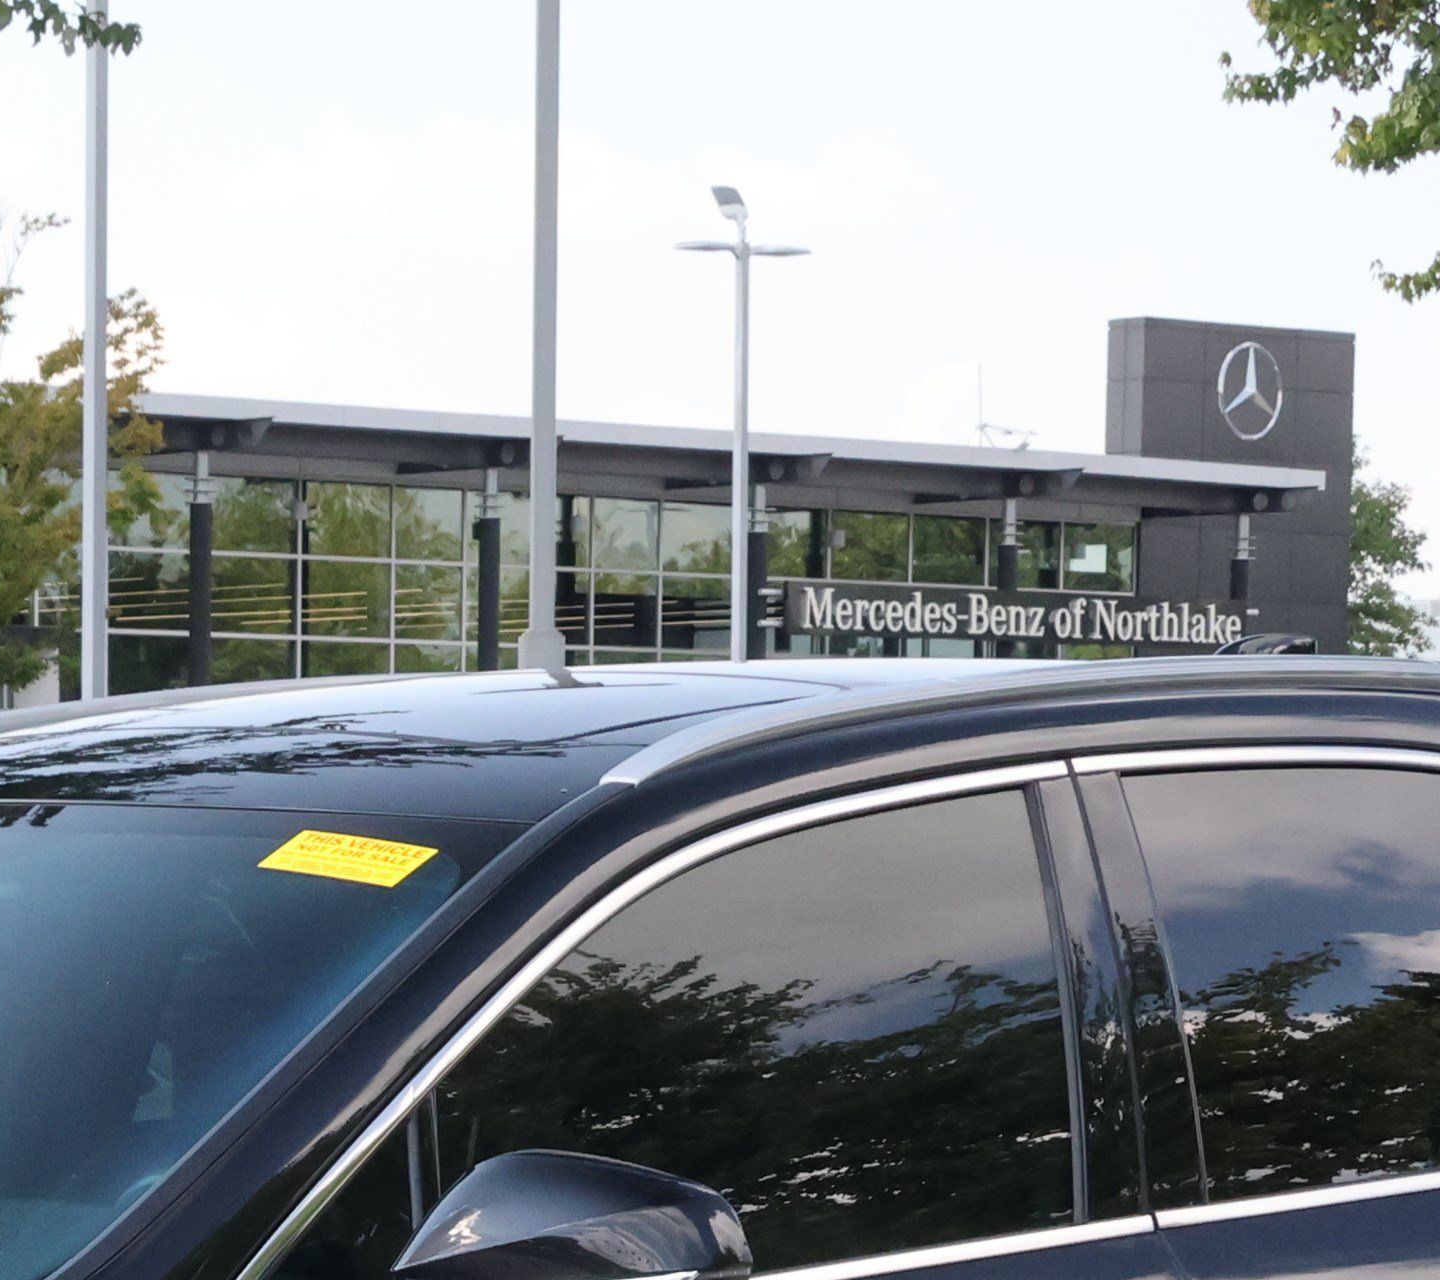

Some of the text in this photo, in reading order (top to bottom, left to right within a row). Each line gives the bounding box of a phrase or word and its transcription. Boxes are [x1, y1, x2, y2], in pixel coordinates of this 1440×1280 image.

[802, 586, 1242, 644] Mercedes-Benz of Northlake
[297, 843, 330, 853] NOT
[333, 847, 365, 858] FOR
[371, 854, 414, 867] SALE
[303, 833, 429, 859] THIS VEHICLE
